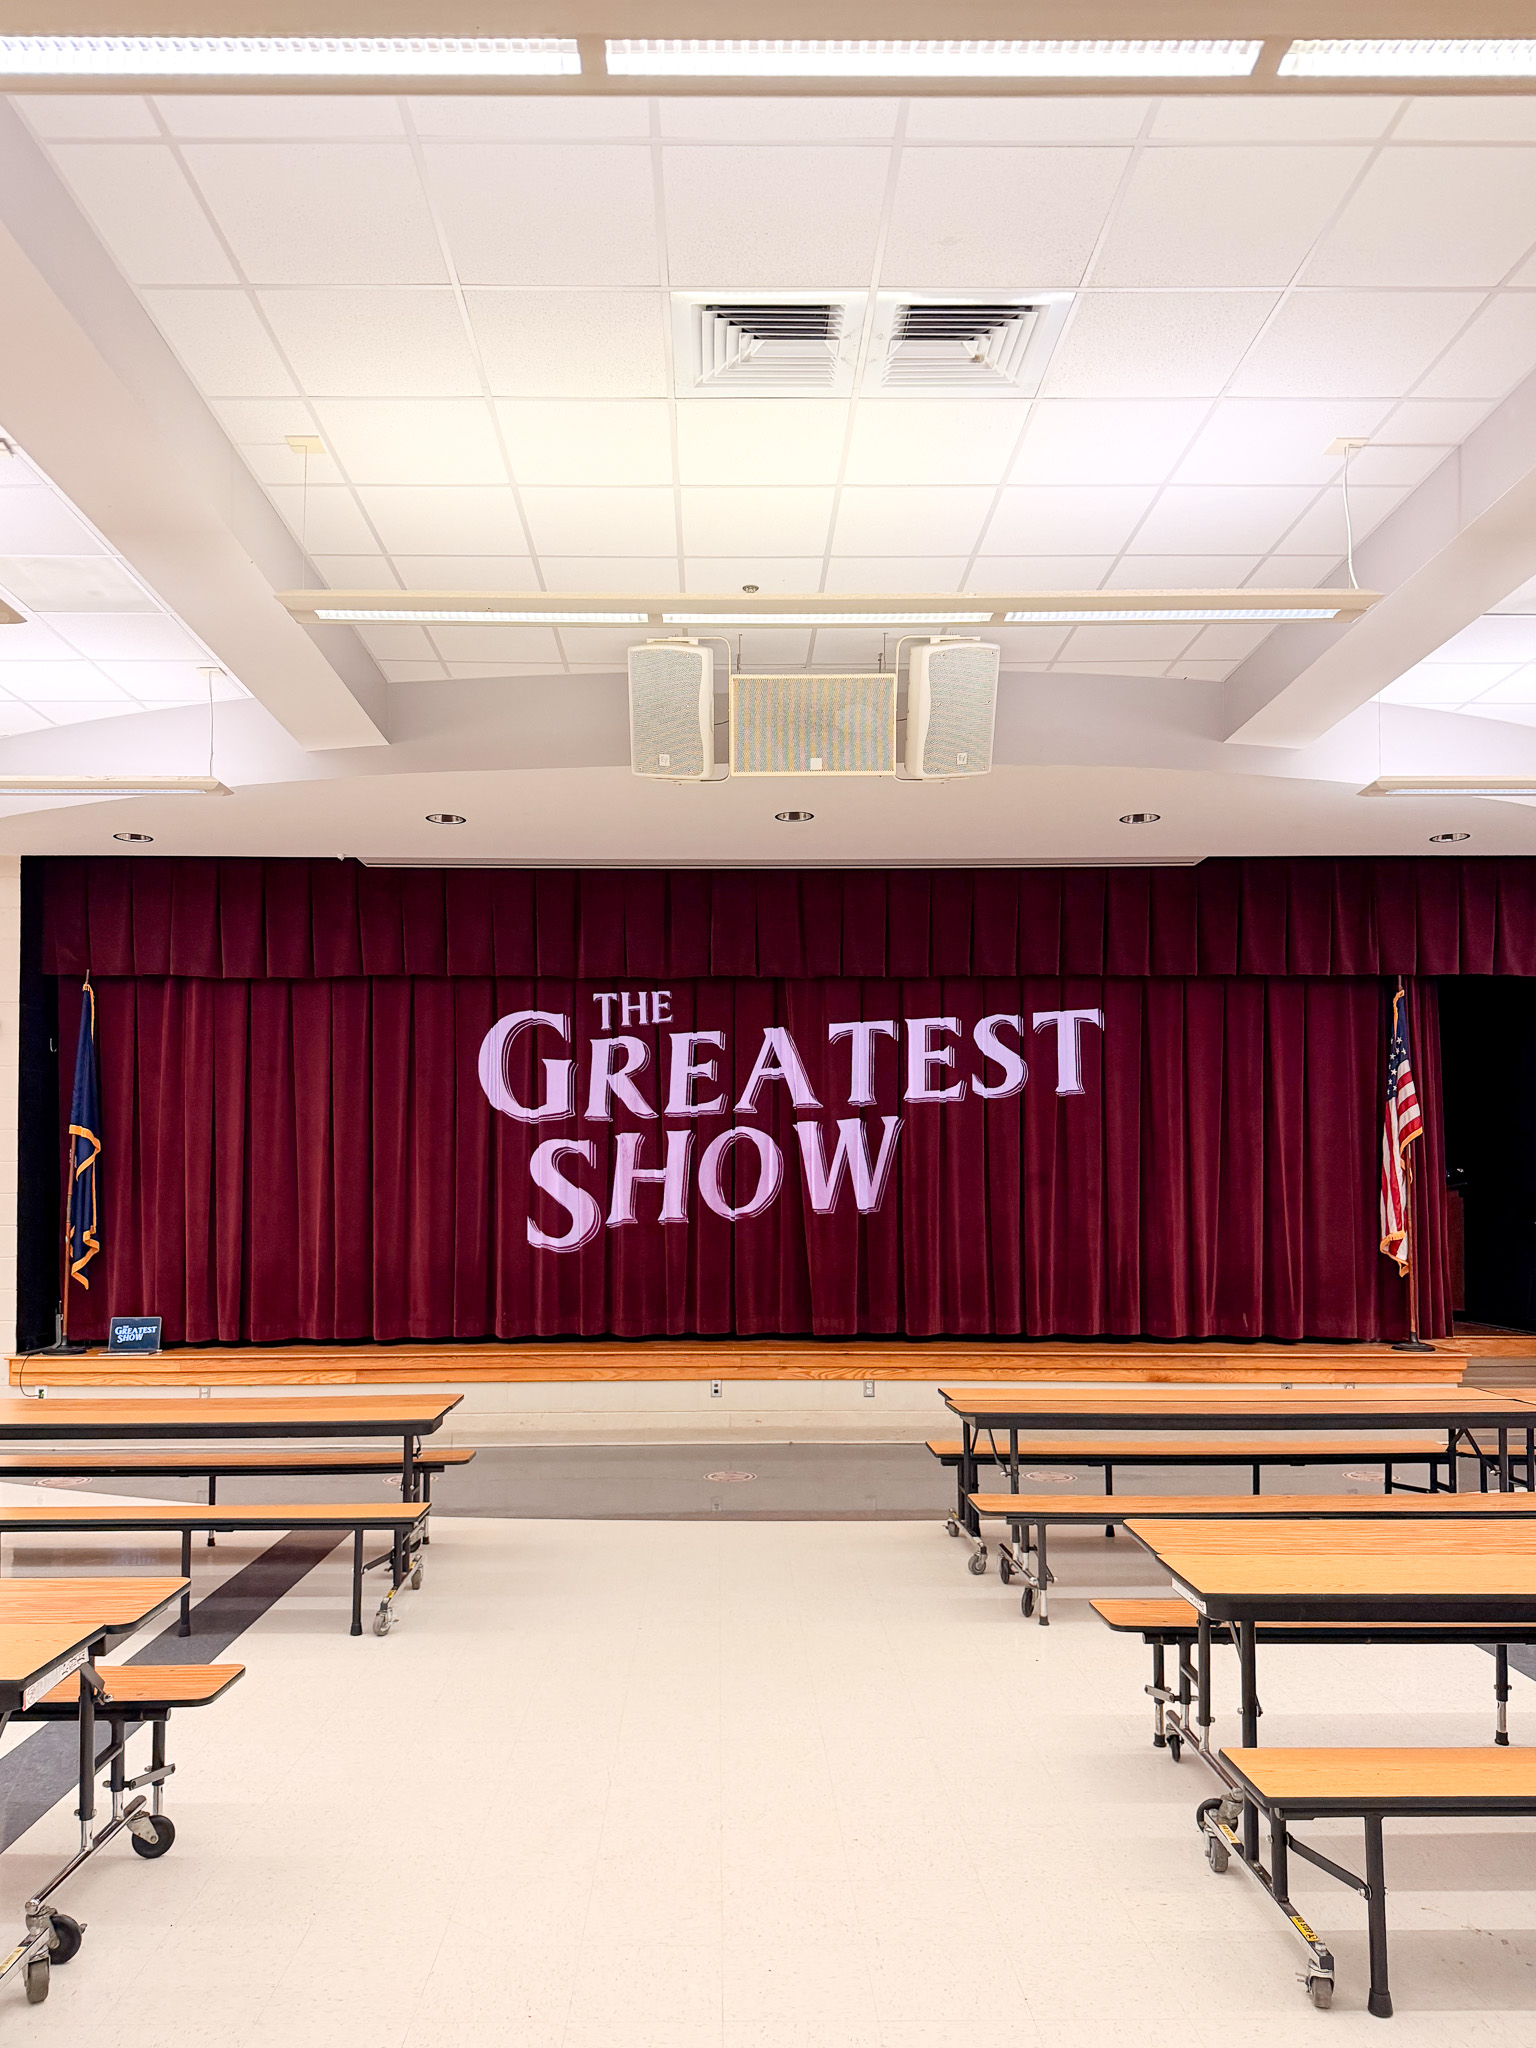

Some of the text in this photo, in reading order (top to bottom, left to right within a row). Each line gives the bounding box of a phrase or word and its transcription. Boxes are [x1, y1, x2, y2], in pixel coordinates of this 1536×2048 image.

[592, 990, 674, 1030] THE
[477, 1008, 1104, 1125] GREATEST
[526, 1115, 905, 1253] SHOW
[114, 1326, 158, 1335] GREATEST
[116, 1333, 144, 1343] SHOW
